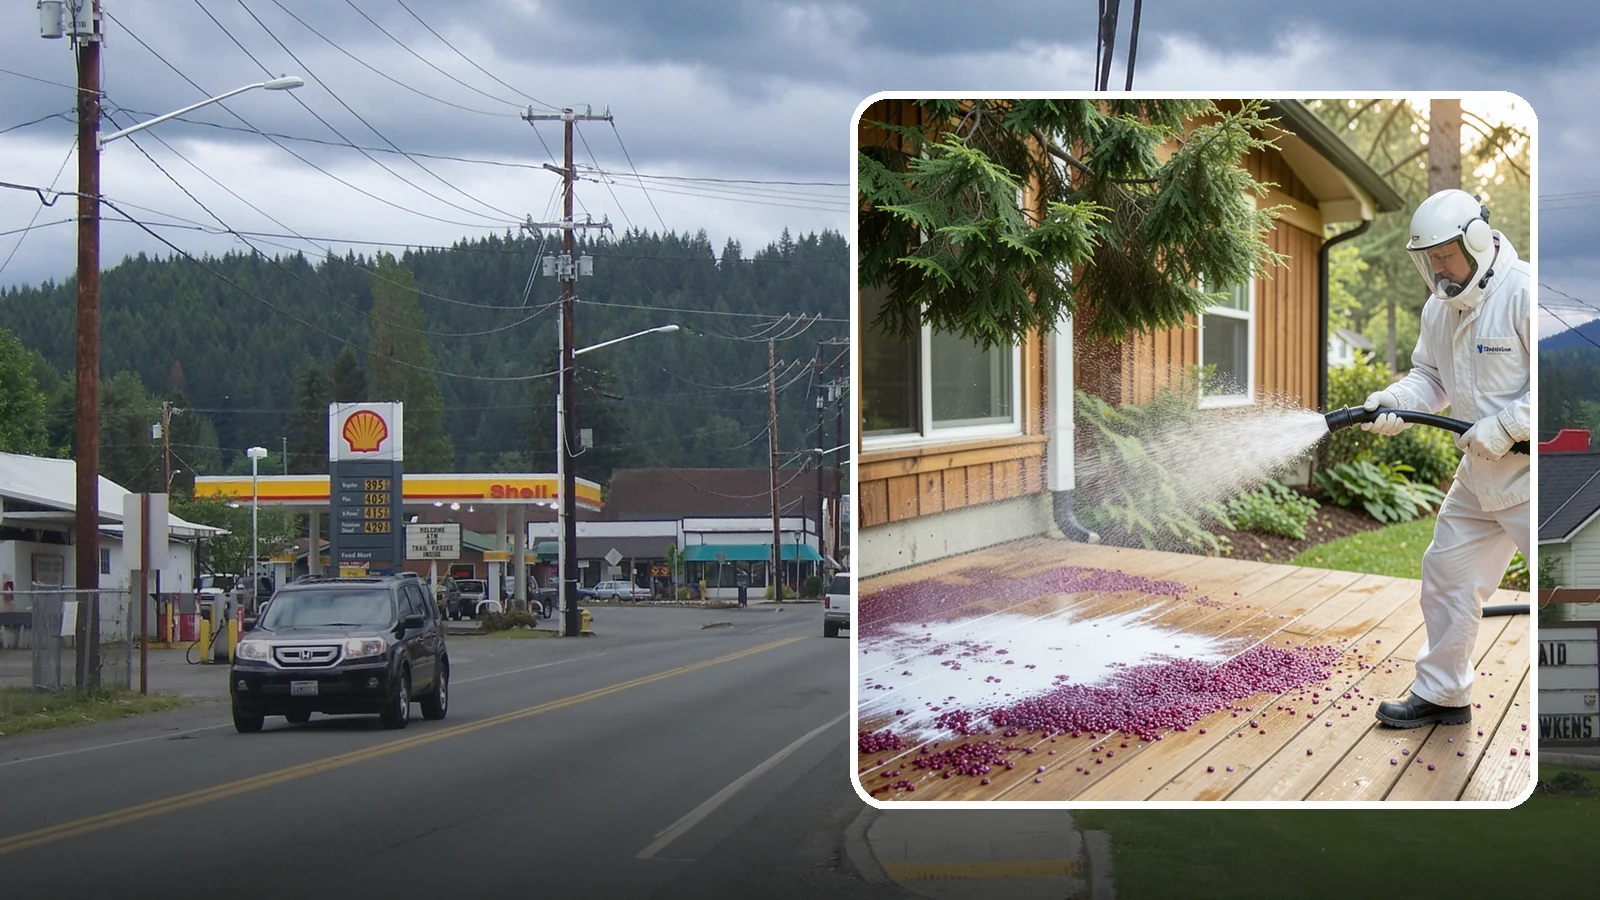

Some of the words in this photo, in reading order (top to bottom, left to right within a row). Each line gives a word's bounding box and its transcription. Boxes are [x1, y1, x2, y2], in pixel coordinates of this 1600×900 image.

[366, 479, 383, 490] 395
[490, 484, 547, 499] Shell
[366, 494, 383, 505] 405
[366, 508, 383, 518] 415
[366, 522, 383, 533] 429
